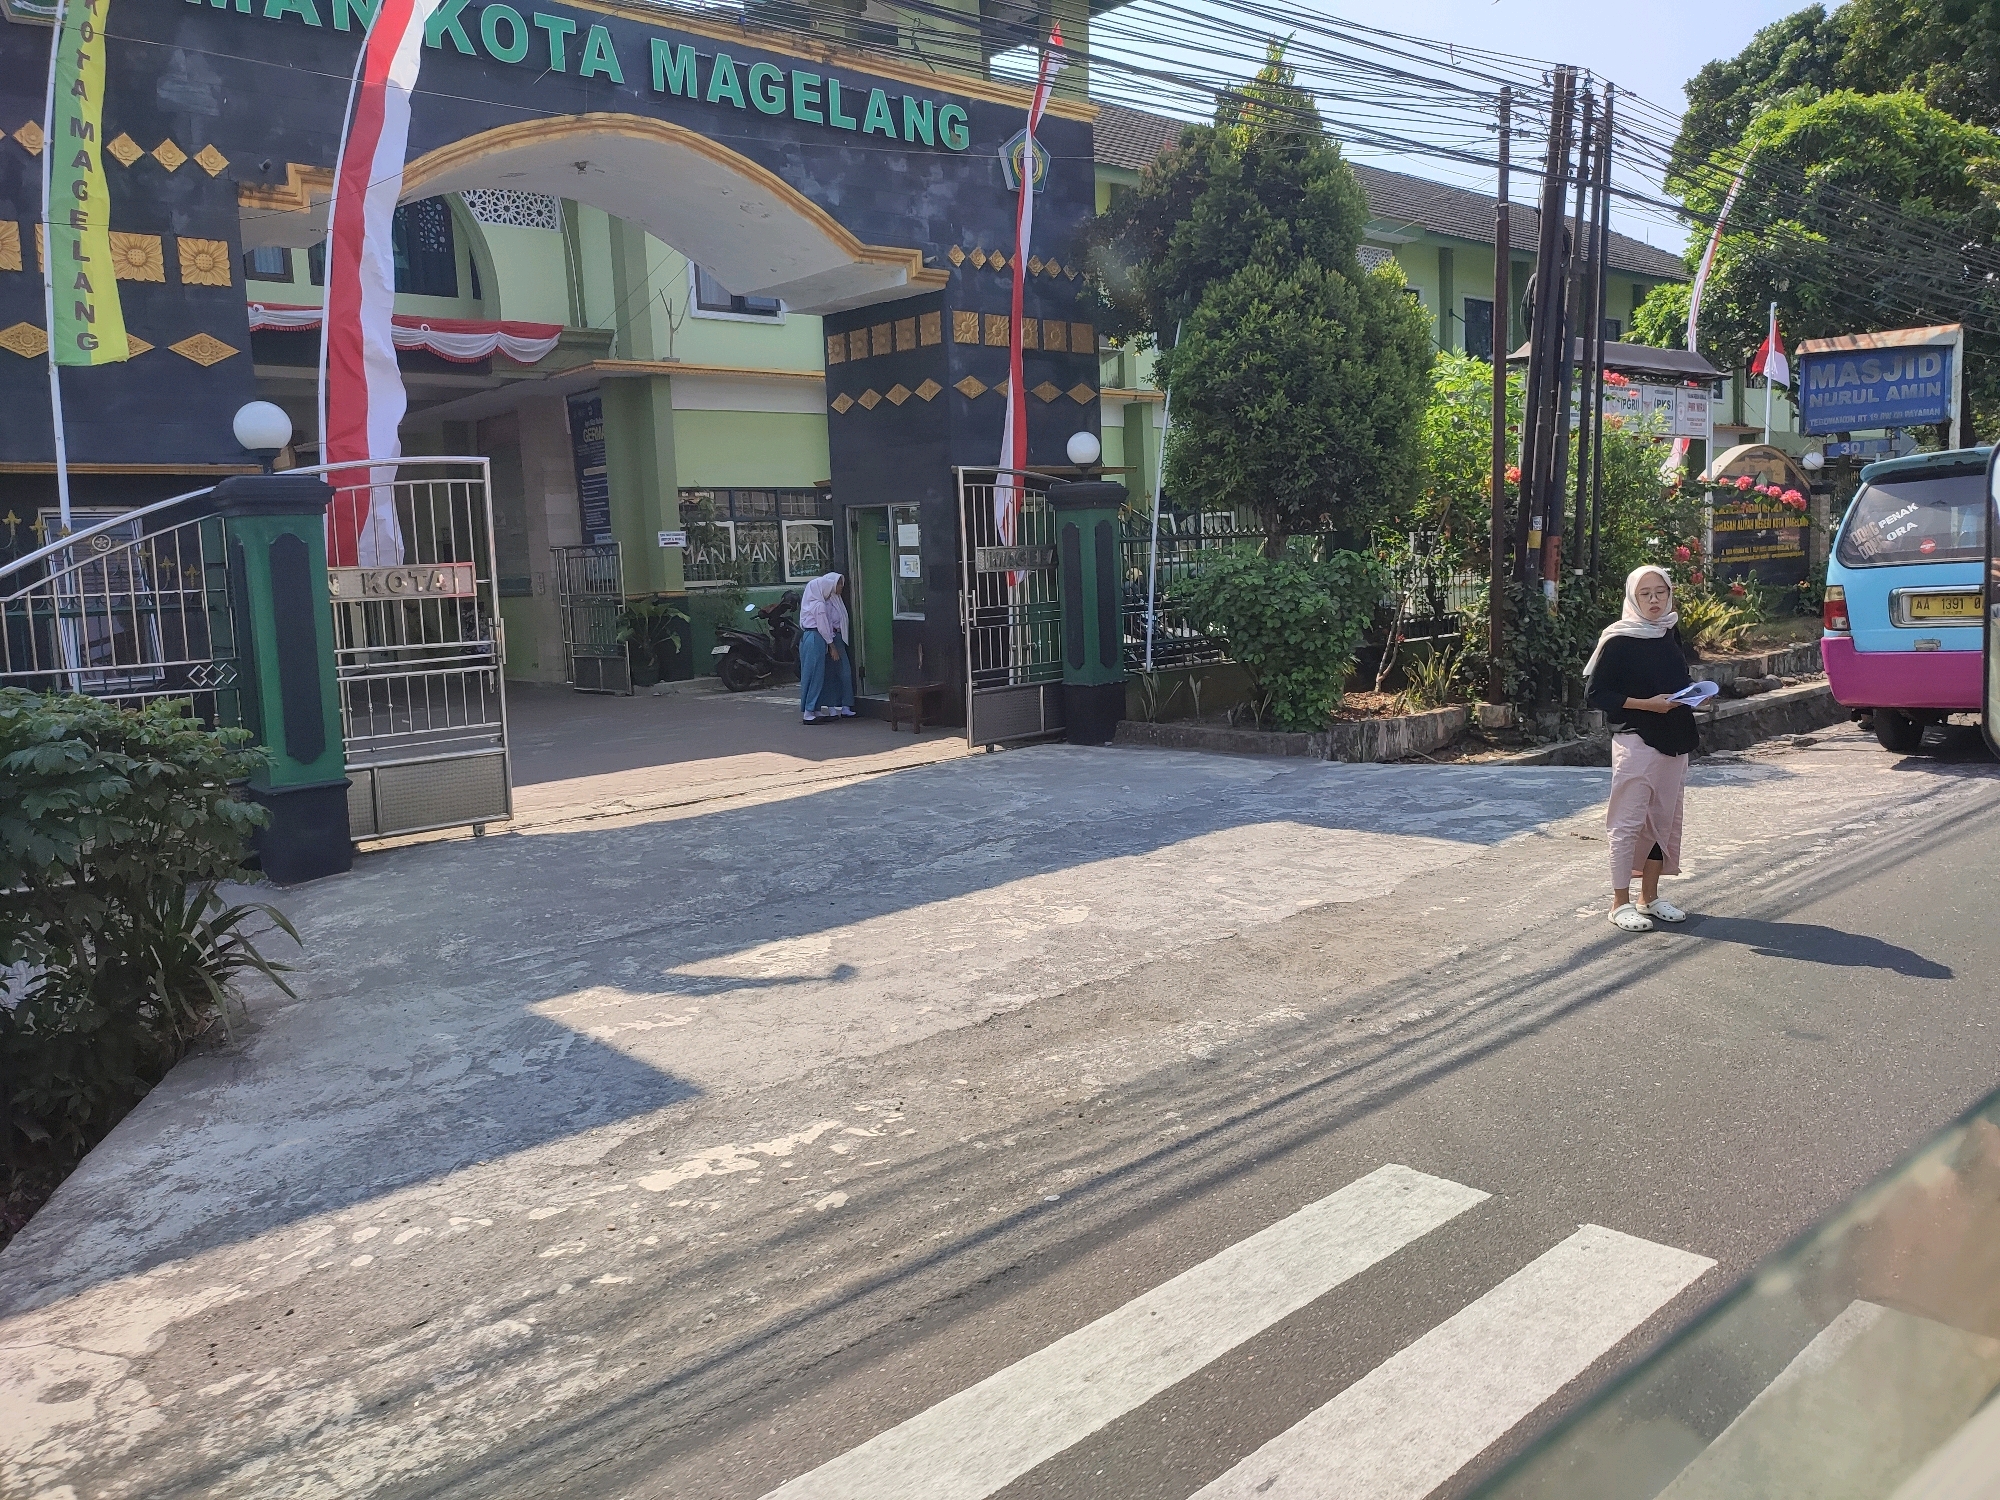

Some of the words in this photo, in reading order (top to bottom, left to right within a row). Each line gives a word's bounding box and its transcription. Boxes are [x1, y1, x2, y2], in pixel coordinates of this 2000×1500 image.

[425, 0, 625, 84] KOTA
[650, 37, 970, 151] MAGELANG
[69, 116, 100, 352] MAGELANG
[1809, 352, 1942, 390] MASJID
[1809, 388, 1880, 408] NURUL
[1885, 382, 1941, 402] AMIN
[1840, 442, 1860, 455] 30
[1878, 502, 1919, 529] PENAK
[1886, 522, 1919, 541] ORA
[361, 570, 447, 595] KOTA
[1916, 599, 1930, 610] AA
[1941, 598, 1964, 610] 1391
